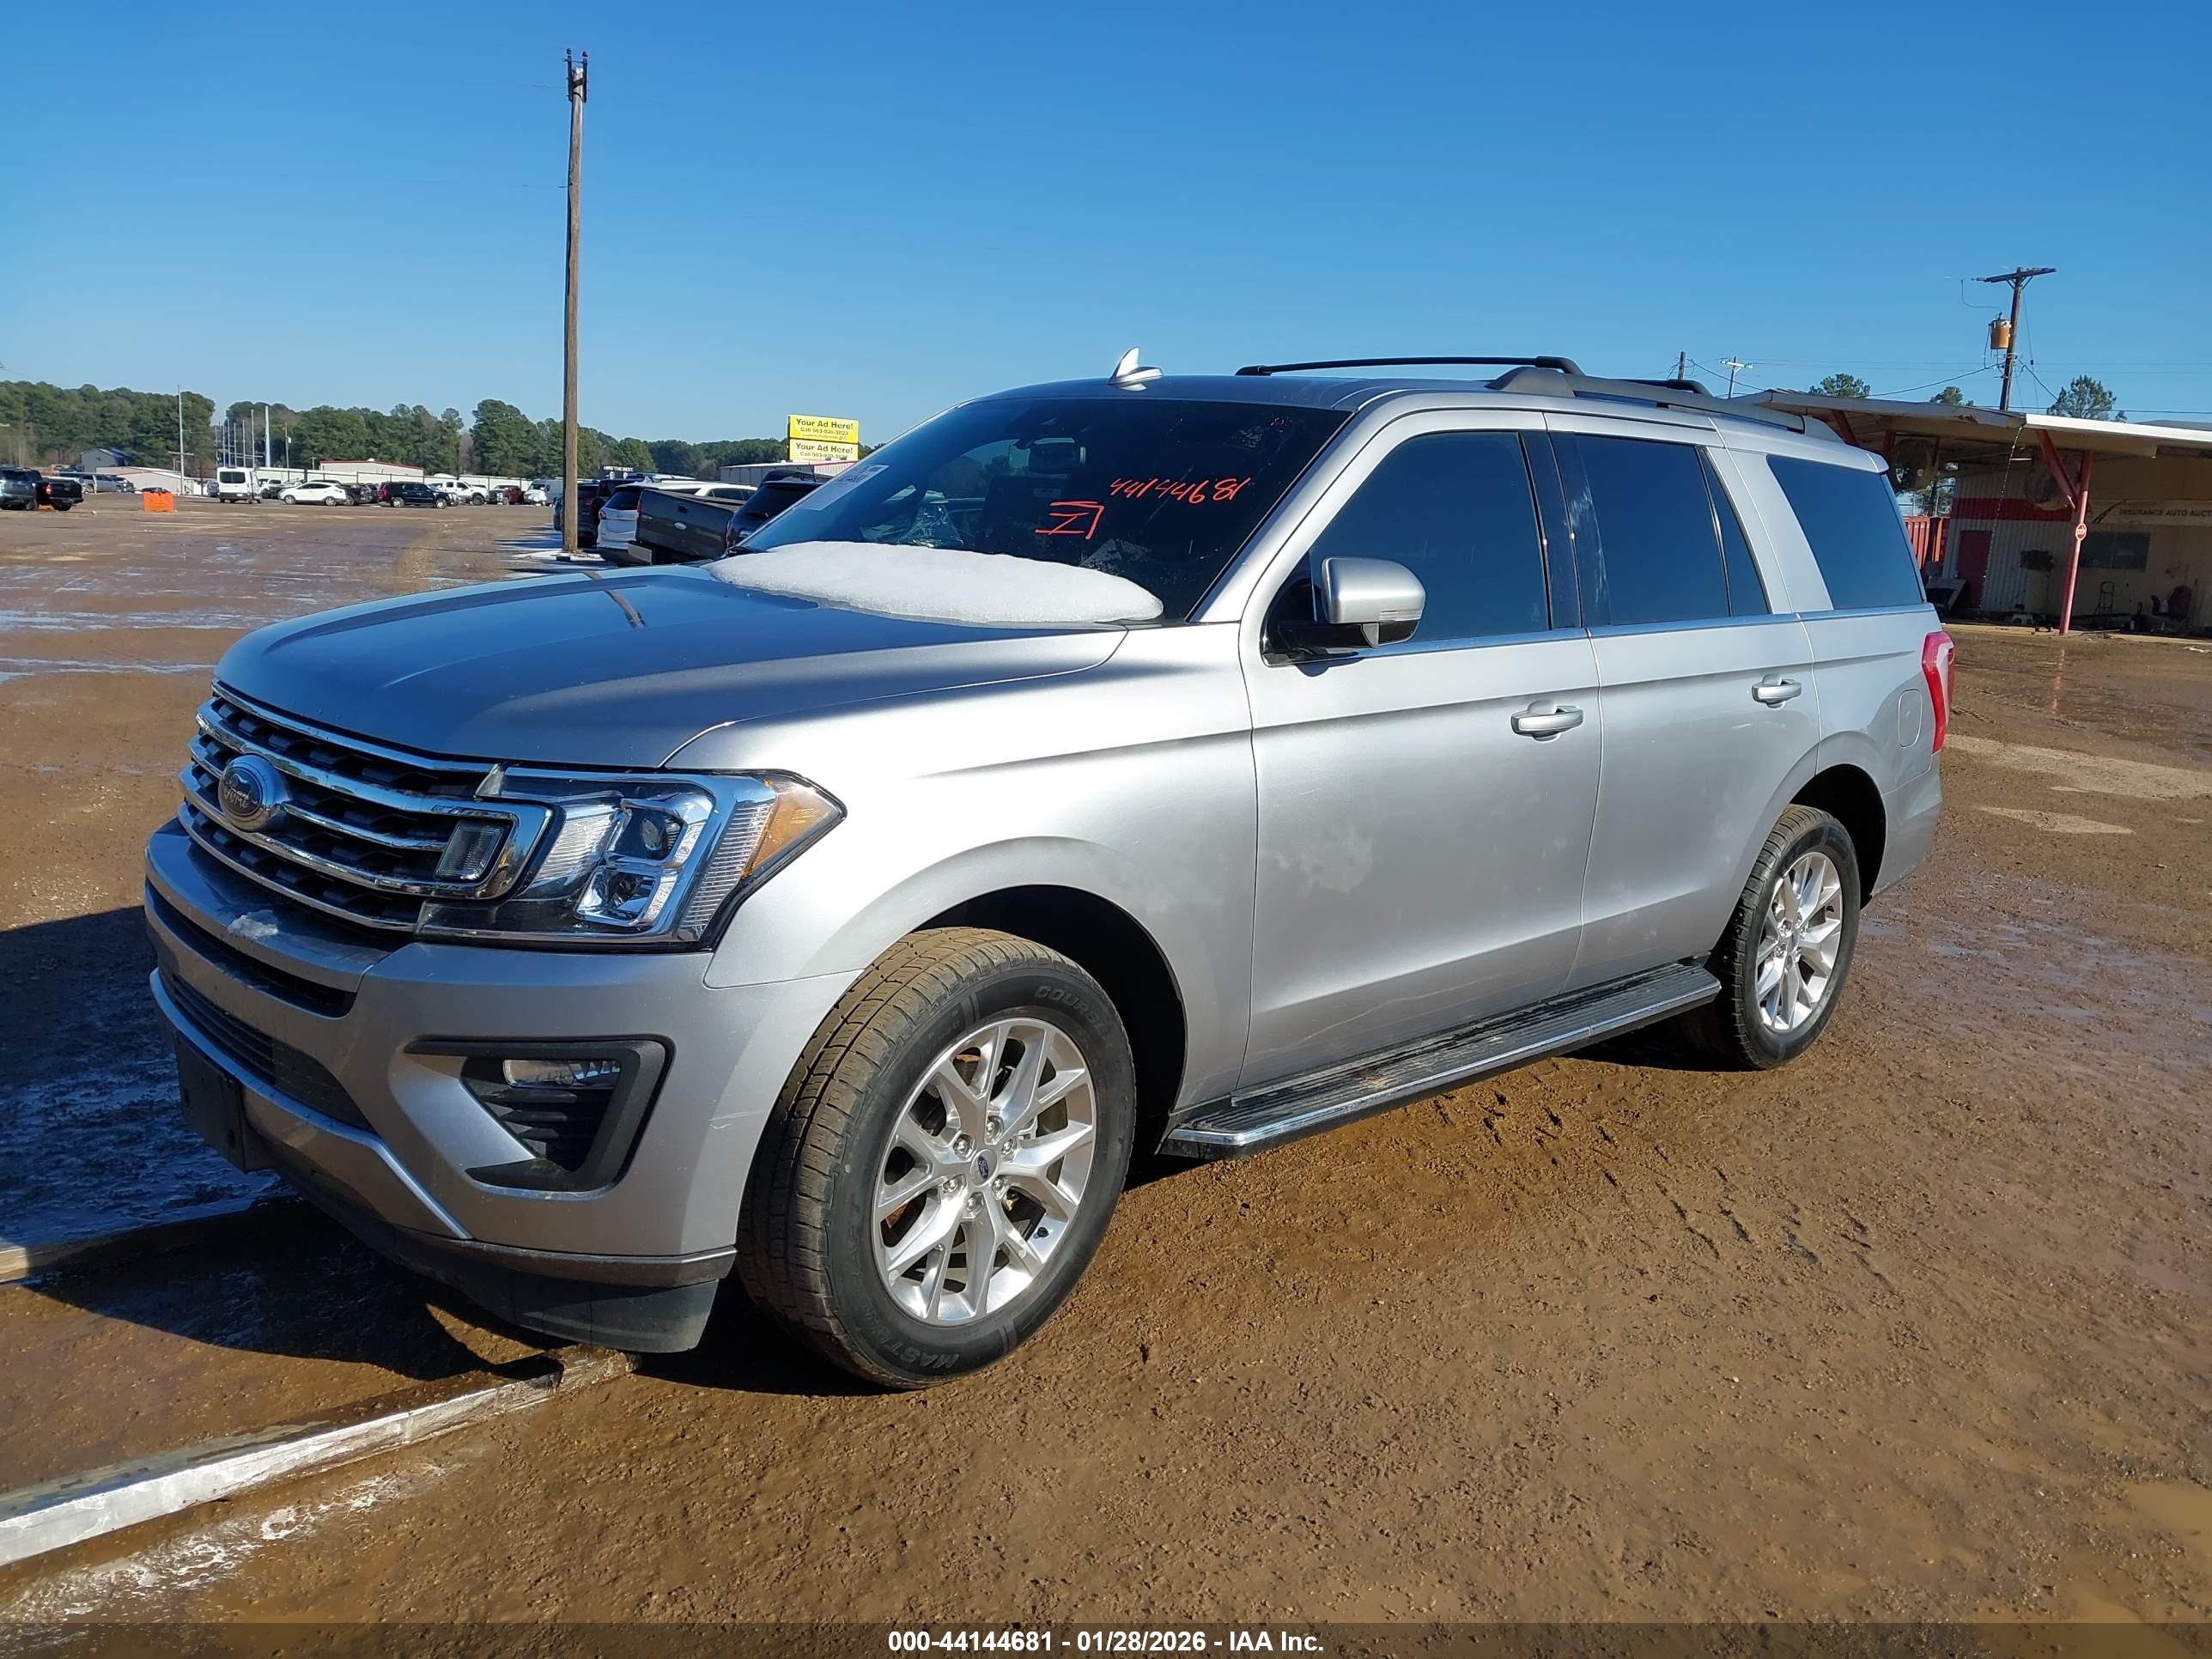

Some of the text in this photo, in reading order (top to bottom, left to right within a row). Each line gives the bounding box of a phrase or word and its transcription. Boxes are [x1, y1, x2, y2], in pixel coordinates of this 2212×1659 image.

[831, 421, 854, 429] Here!
[830, 445, 854, 453] Here!
[2166, 508, 2188, 517] AUTO
